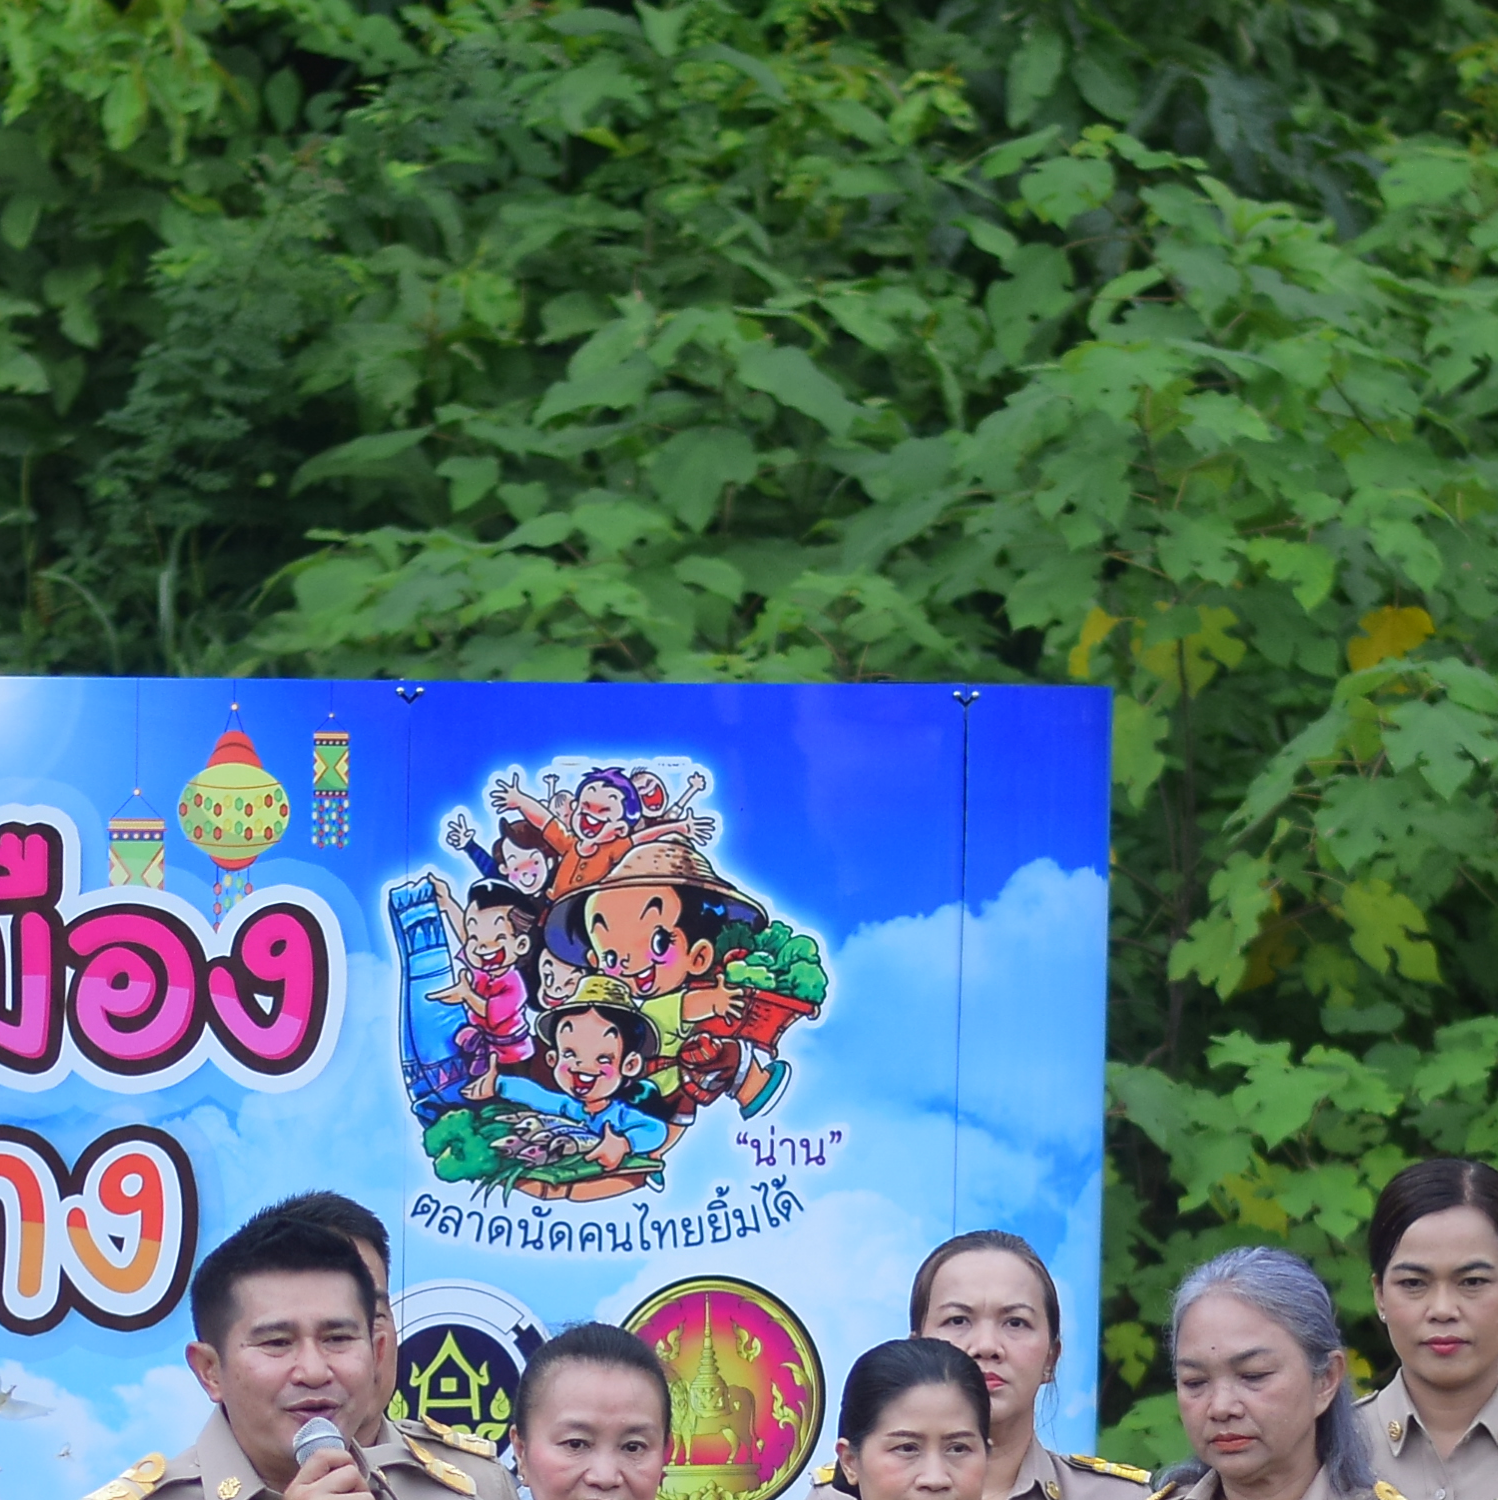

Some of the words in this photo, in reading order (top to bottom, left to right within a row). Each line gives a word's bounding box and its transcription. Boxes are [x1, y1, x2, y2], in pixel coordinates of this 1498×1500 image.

[409, 1173, 804, 1254] ตลาดนัดคนไทยยิ้มได้
